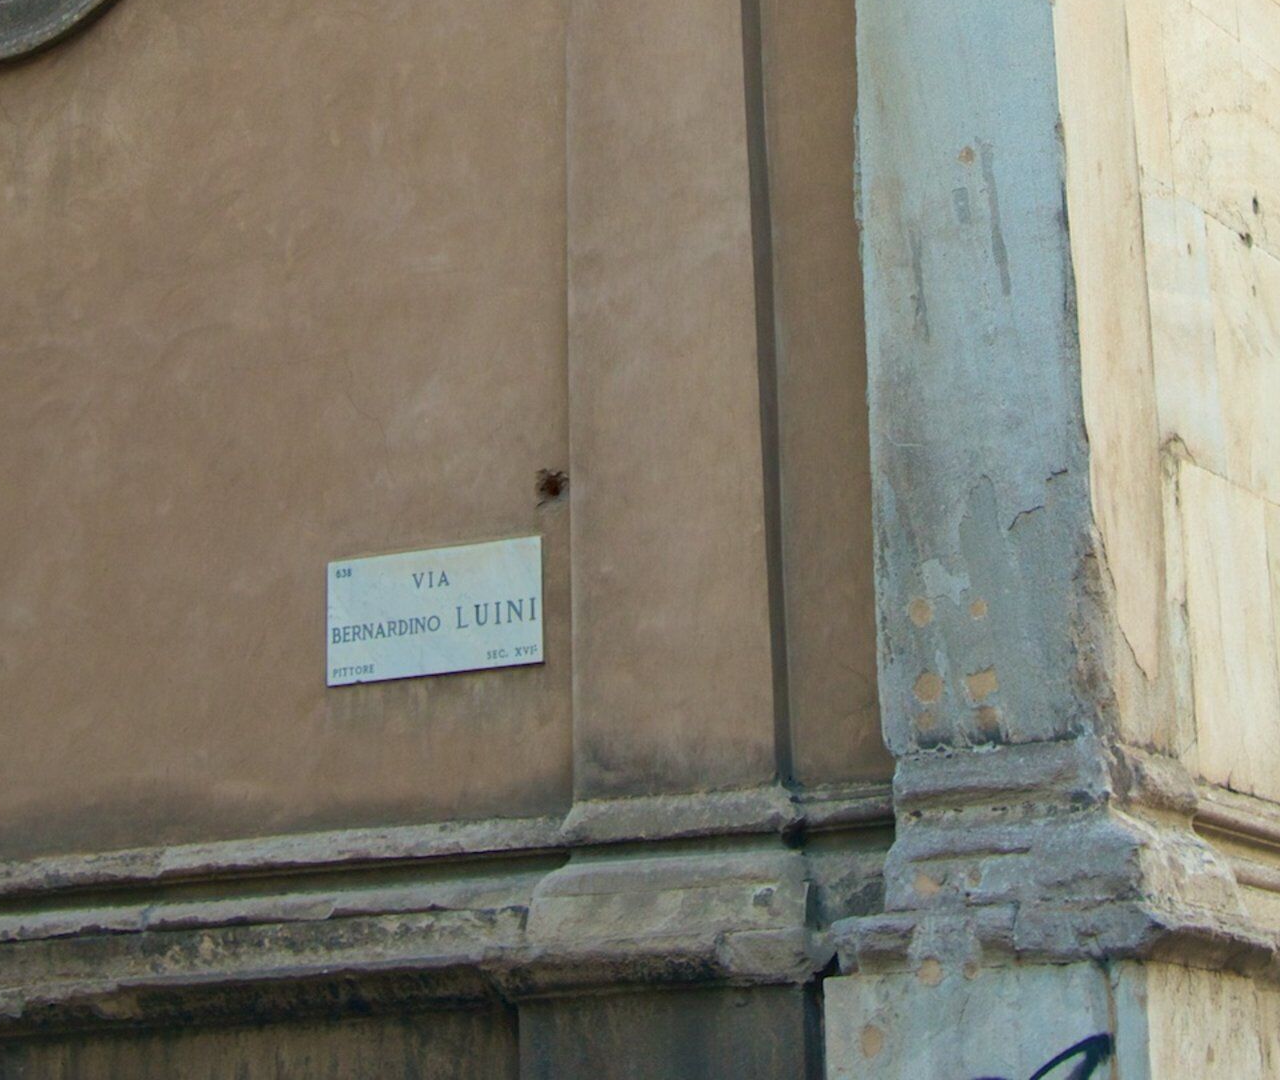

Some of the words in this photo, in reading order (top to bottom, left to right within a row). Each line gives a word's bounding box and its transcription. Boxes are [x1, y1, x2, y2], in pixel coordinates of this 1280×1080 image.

[412, 570, 450, 589] VIA
[331, 615, 441, 645] BERNARDINO
[455, 596, 537, 629] LUINI
[486, 648, 509, 660] SEC.
[332, 663, 376, 679] PITTORE
